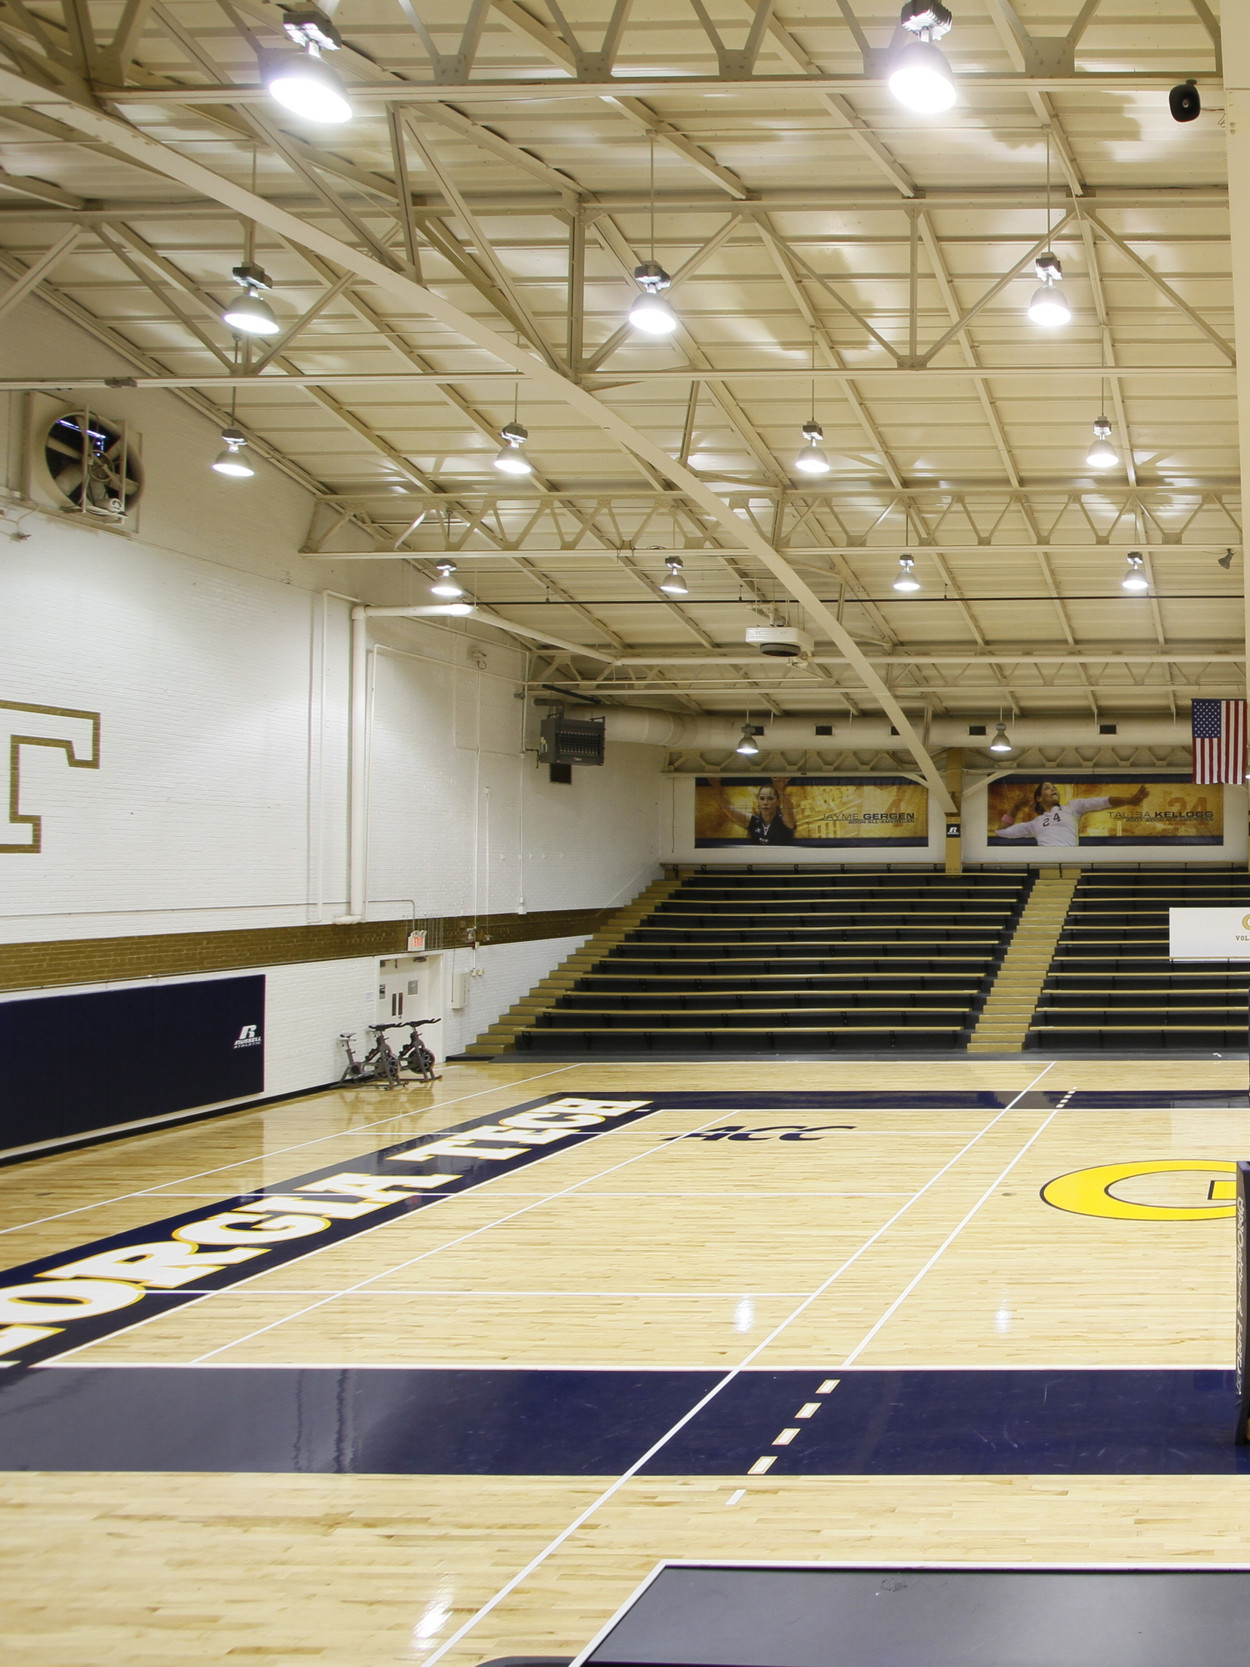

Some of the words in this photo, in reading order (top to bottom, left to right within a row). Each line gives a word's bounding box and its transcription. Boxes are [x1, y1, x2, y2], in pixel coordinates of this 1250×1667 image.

[863, 812, 915, 820] GERGEN
[1043, 812, 1061, 828] 24
[661, 1125, 858, 1141] ACC
[0, 1172, 463, 1368] ORGIA
[387, 1097, 654, 1163] TECH
